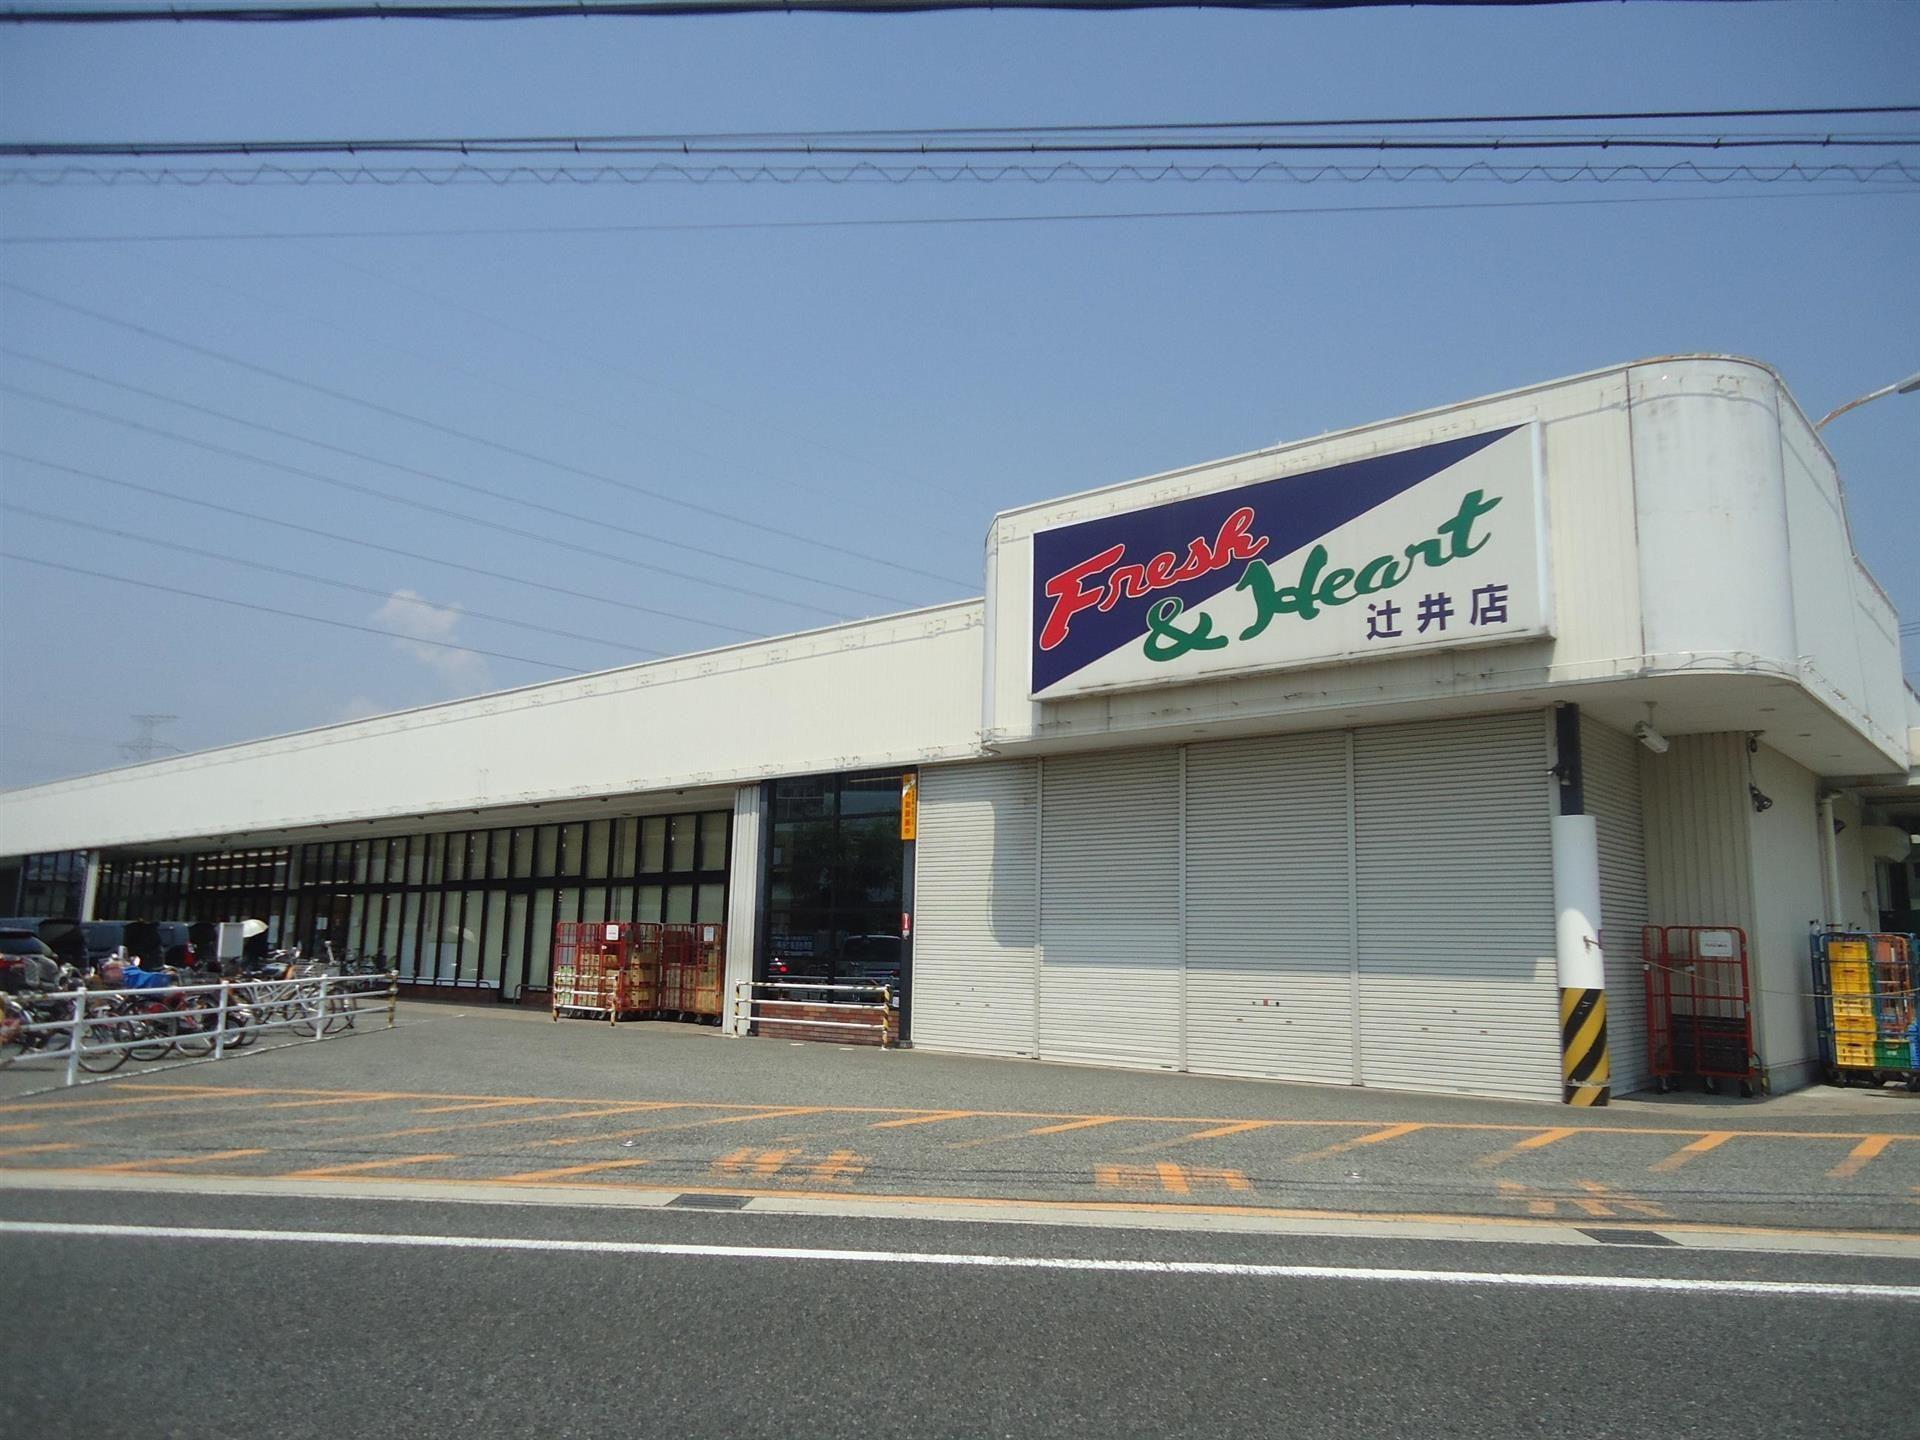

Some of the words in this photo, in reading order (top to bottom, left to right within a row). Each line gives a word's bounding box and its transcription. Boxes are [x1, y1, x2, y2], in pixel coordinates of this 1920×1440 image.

[1039, 507, 1270, 651] Fresh
[1143, 597, 1229, 662] &
[1236, 489, 1503, 641] Heart
[1366, 584, 1509, 641] 辻井店
